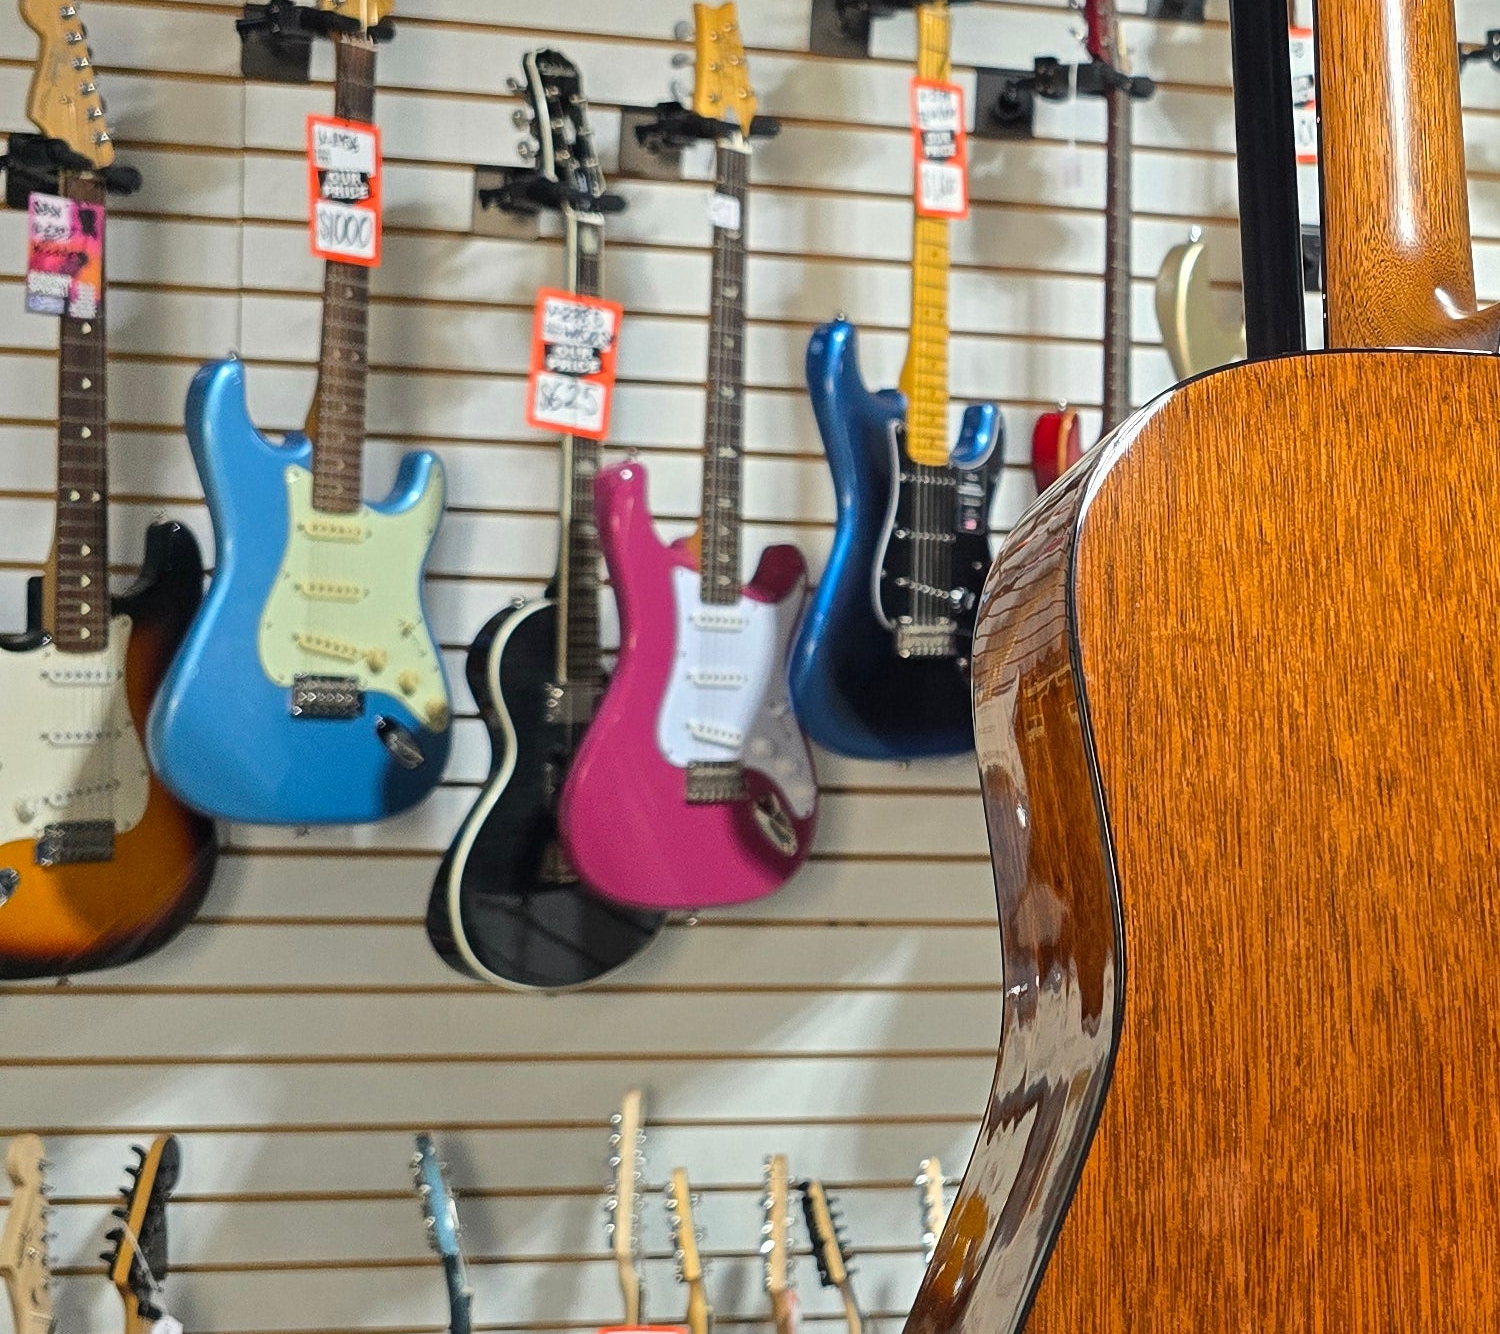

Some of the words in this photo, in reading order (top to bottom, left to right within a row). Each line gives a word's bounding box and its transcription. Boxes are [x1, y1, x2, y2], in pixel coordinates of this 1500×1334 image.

[327, 171, 362, 186] OUR
[321, 183, 371, 200] PRICE
[318, 210, 373, 249] $1000
[553, 344, 594, 362] OUR
[545, 357, 602, 374] PRICE
